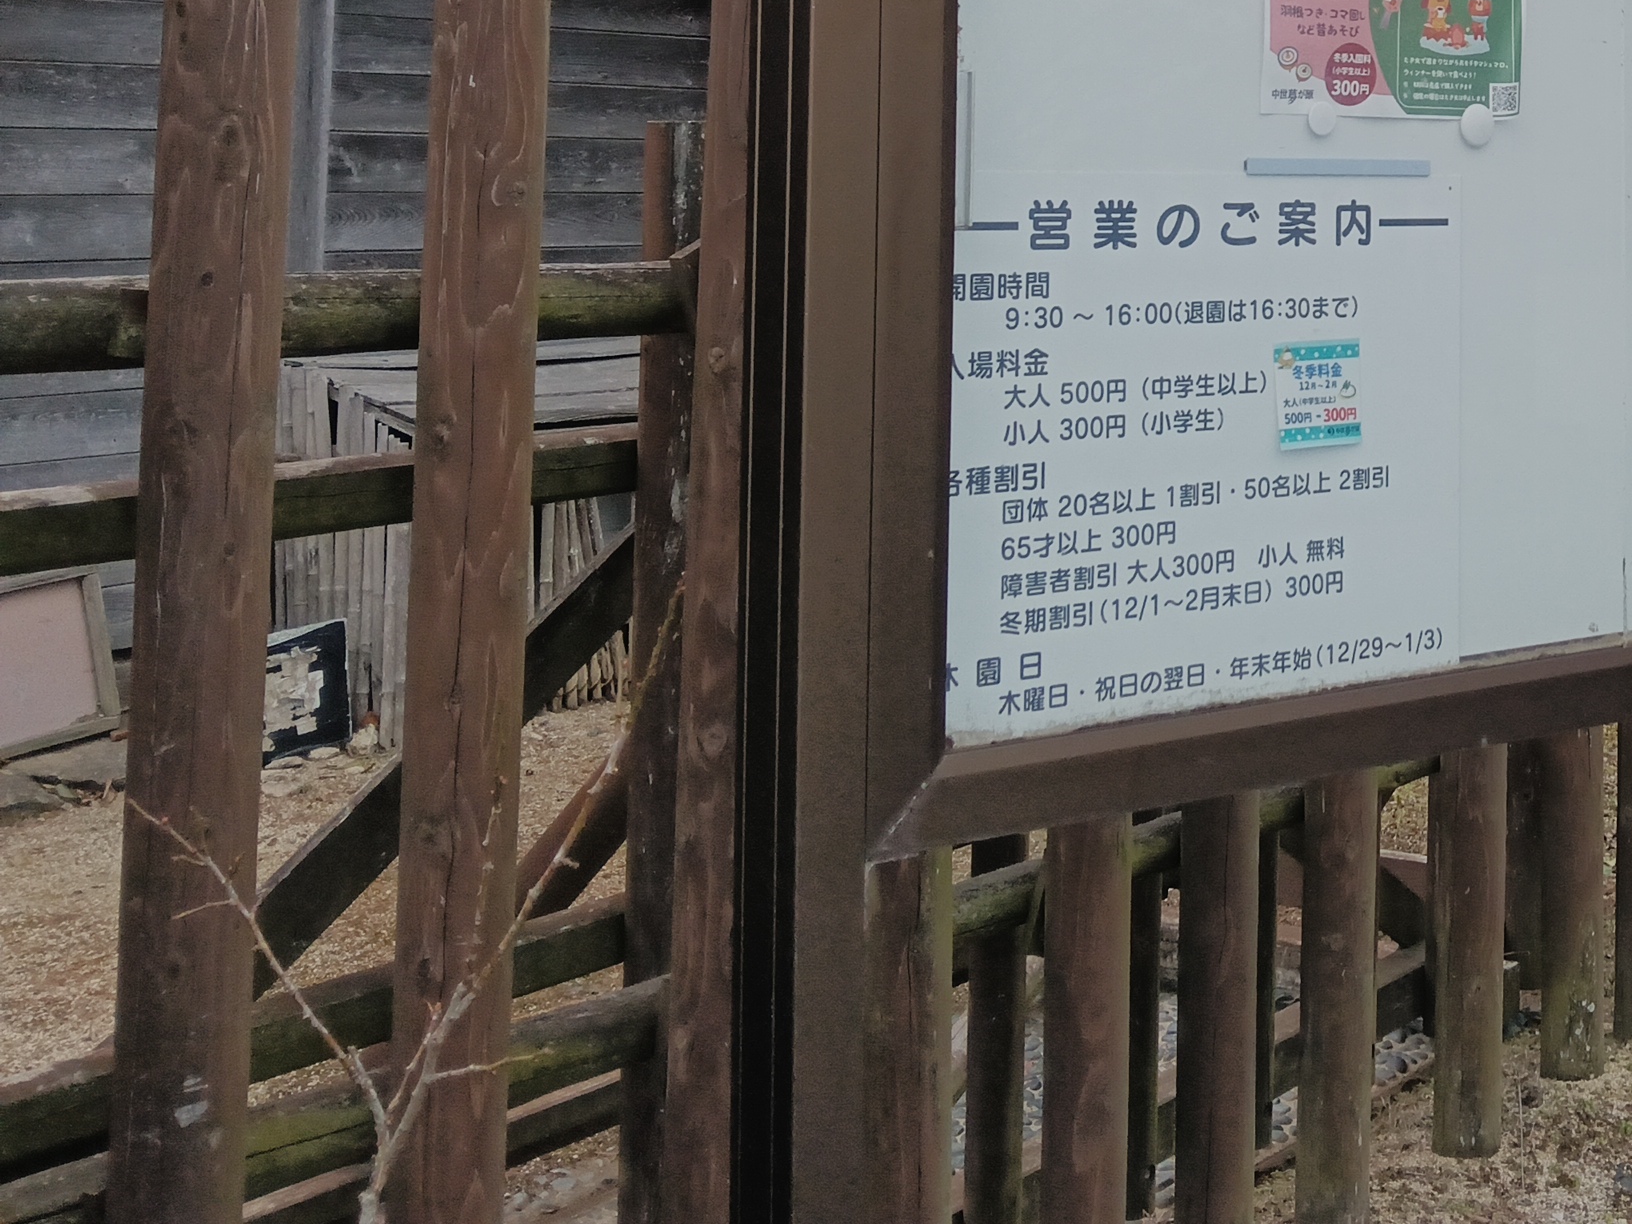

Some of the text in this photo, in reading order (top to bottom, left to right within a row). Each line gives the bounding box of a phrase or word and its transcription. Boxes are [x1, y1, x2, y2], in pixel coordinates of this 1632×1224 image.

[1331, 79, 1370, 96] 300円
[1028, 199, 1372, 250] 営業のご案内
[1292, 362, 1343, 380] 冬季料金
[1003, 384, 1051, 409] 大人
[1060, 379, 1127, 404] 500円
[1003, 419, 1050, 446] 小人
[1059, 414, 1127, 440] 300円
[1284, 407, 1357, 425] 500円 300円
[948, 461, 1046, 498] 各種割引
[1002, 496, 1049, 525] 団体
[1001, 521, 1177, 561] 65才以上 300円
[1000, 536, 1346, 600] 障害者割引 大人300円 小人 無料
